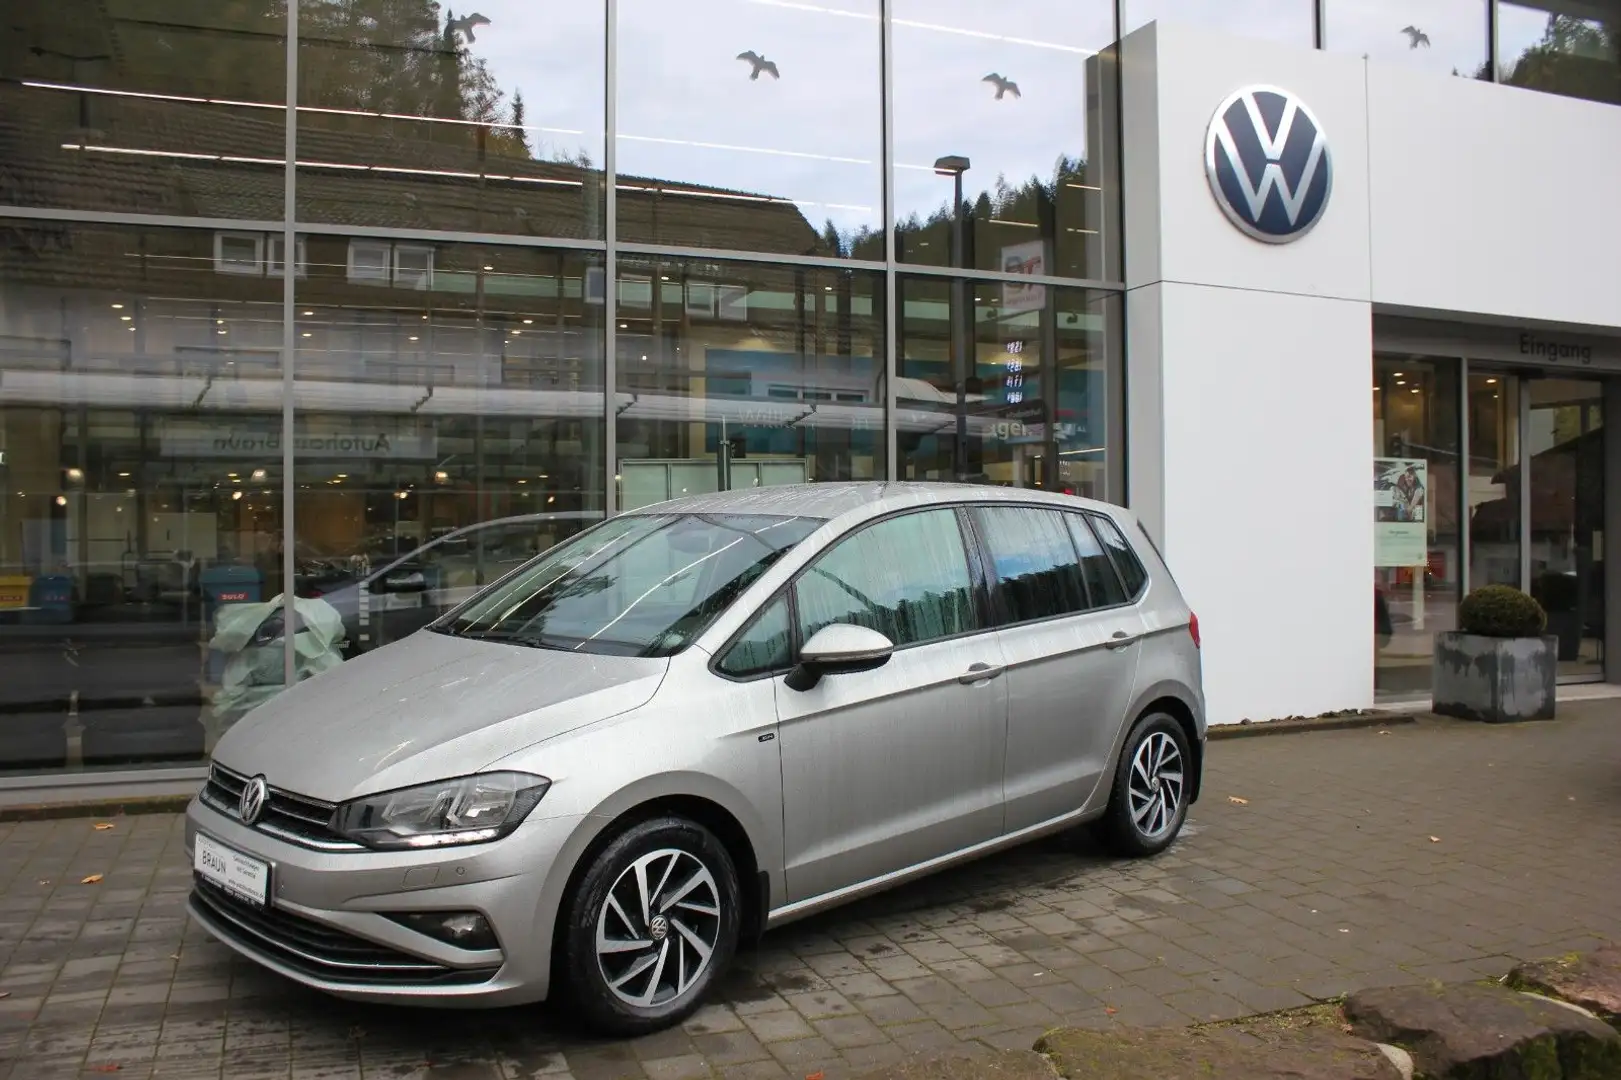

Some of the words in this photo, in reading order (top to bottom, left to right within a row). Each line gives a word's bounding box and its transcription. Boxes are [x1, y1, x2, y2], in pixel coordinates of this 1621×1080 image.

[1206, 85, 1331, 241] VW
[1520, 332, 1592, 365] Eingang
[202, 850, 226, 874] BRAUN
